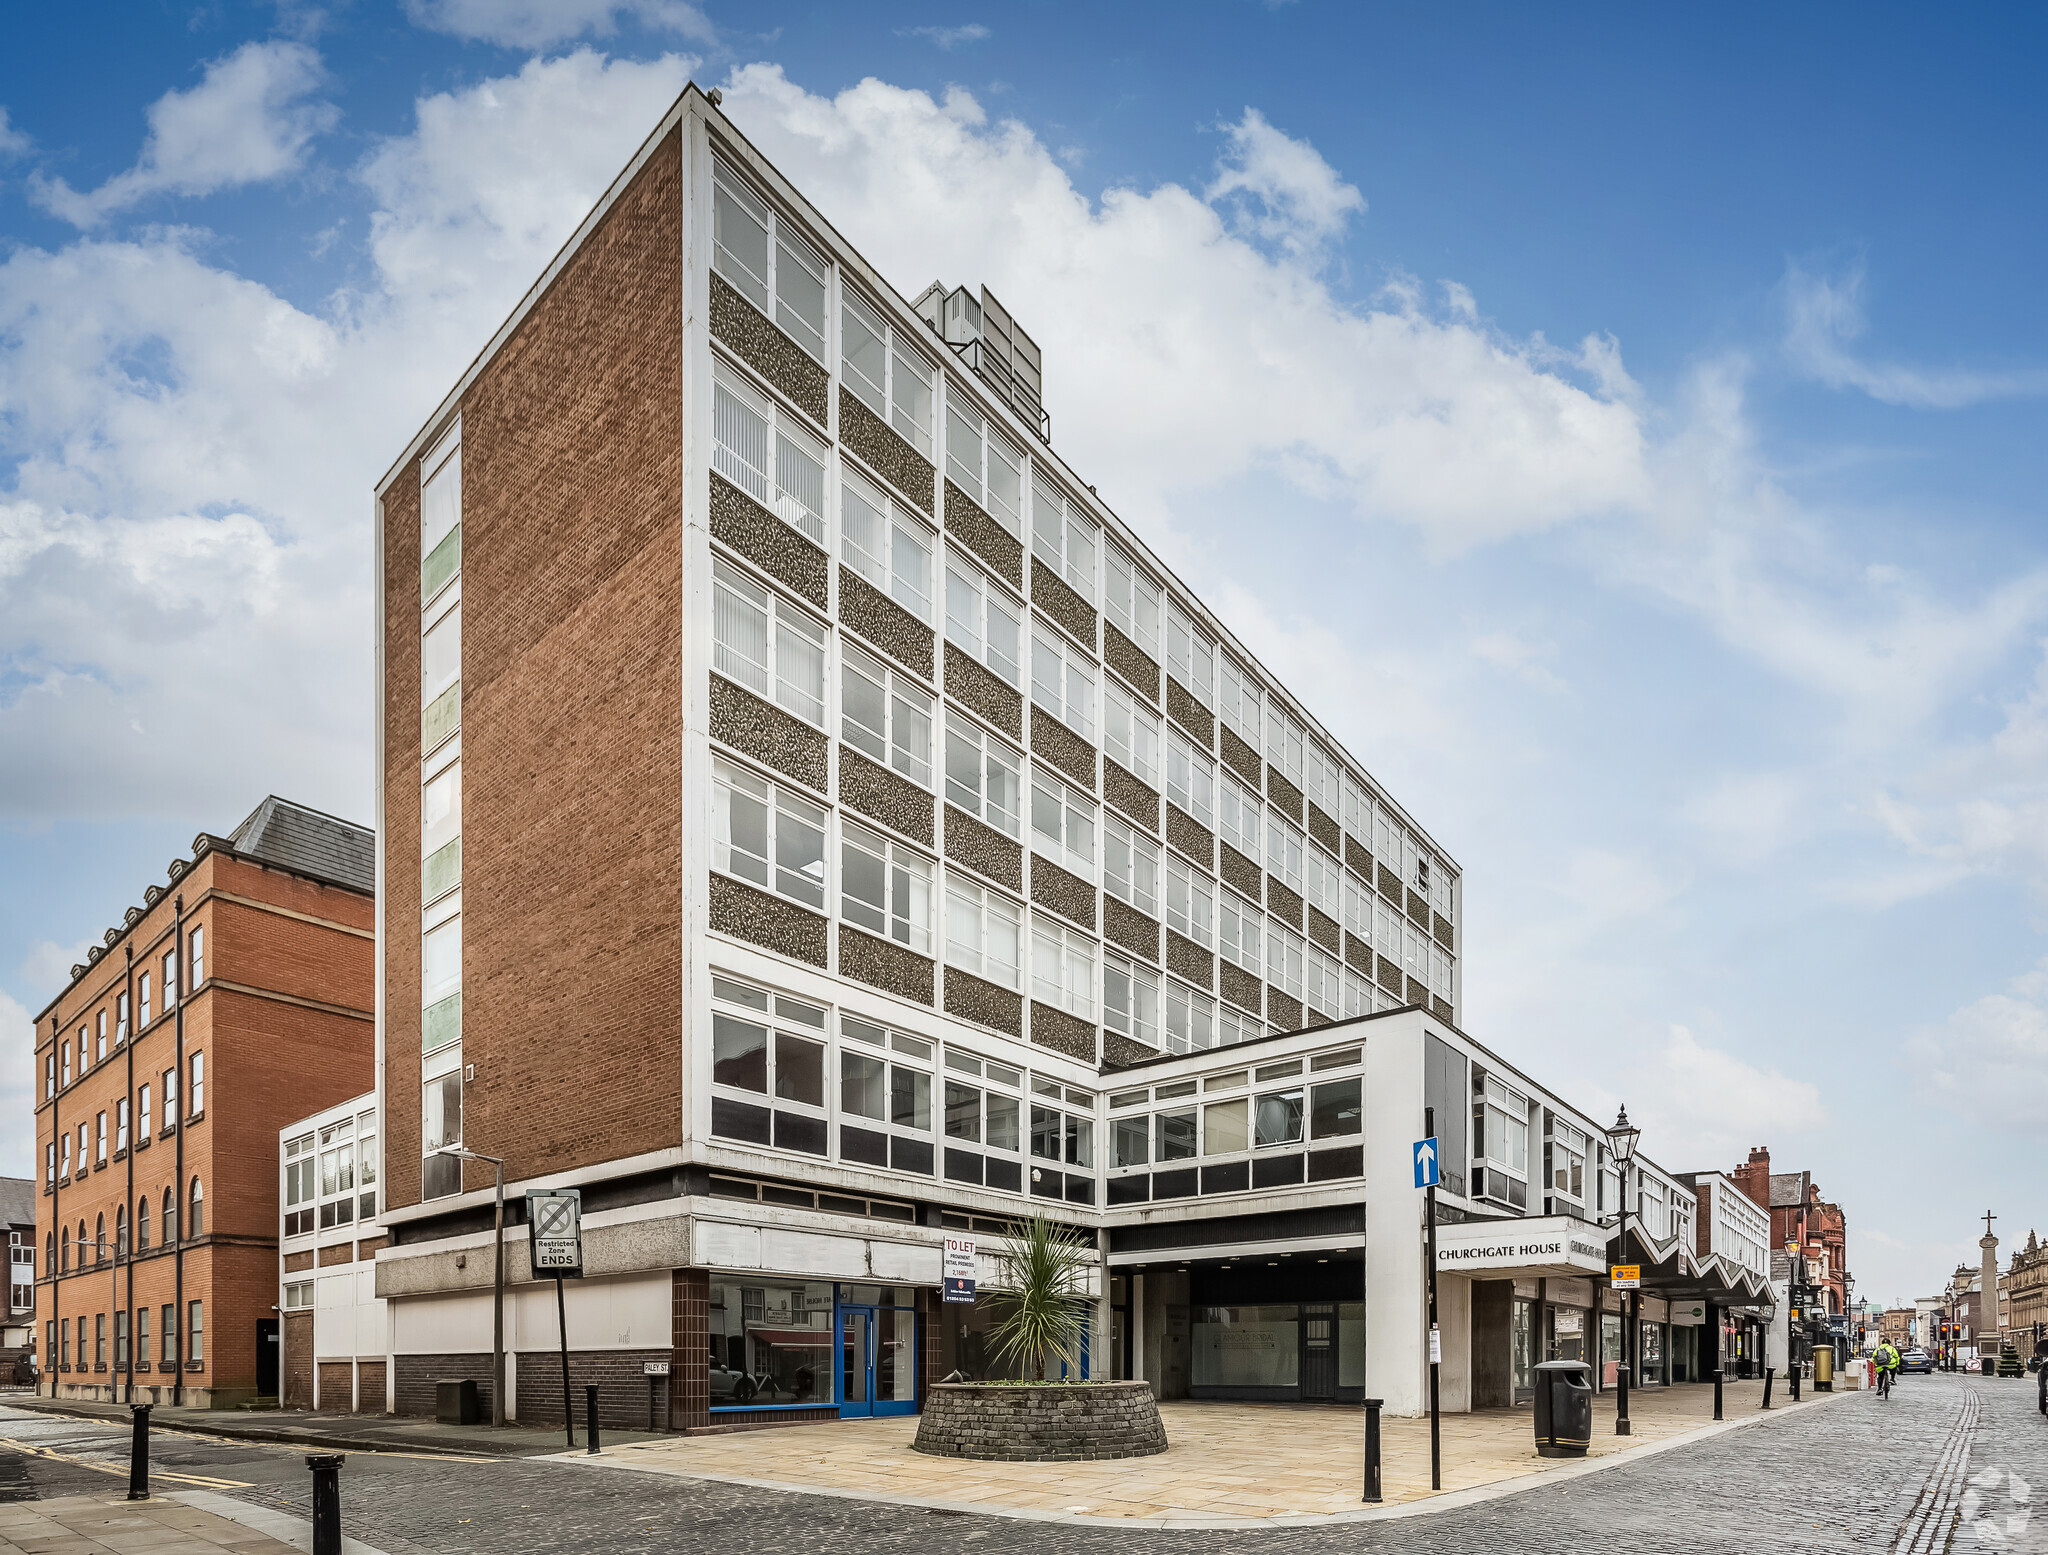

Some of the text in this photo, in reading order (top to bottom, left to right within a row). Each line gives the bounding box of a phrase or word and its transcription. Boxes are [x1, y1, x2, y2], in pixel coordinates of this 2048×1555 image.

[946, 1240, 974, 1252] TO LET
[1438, 1243, 1561, 1260] CHURCHGATE HOUSE
[542, 1256, 573, 1264] ENDS
